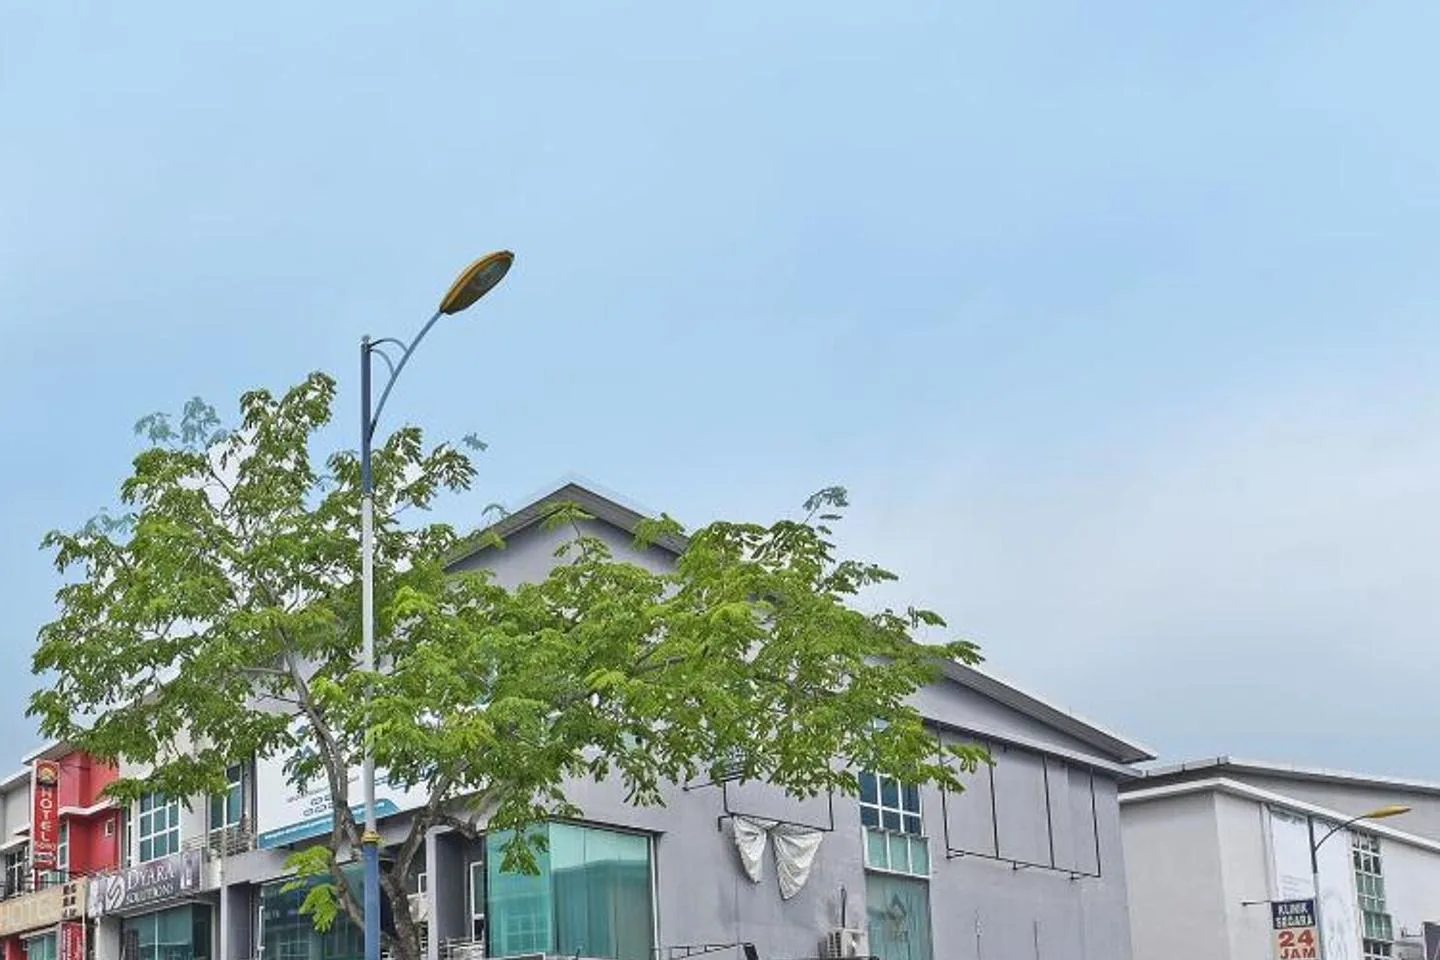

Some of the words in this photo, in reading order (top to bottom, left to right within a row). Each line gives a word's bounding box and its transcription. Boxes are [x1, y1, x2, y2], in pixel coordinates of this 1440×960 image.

[39, 785, 53, 842] HOTEL
[1278, 929, 1314, 947] 24
[1280, 948, 1316, 960] JAM
